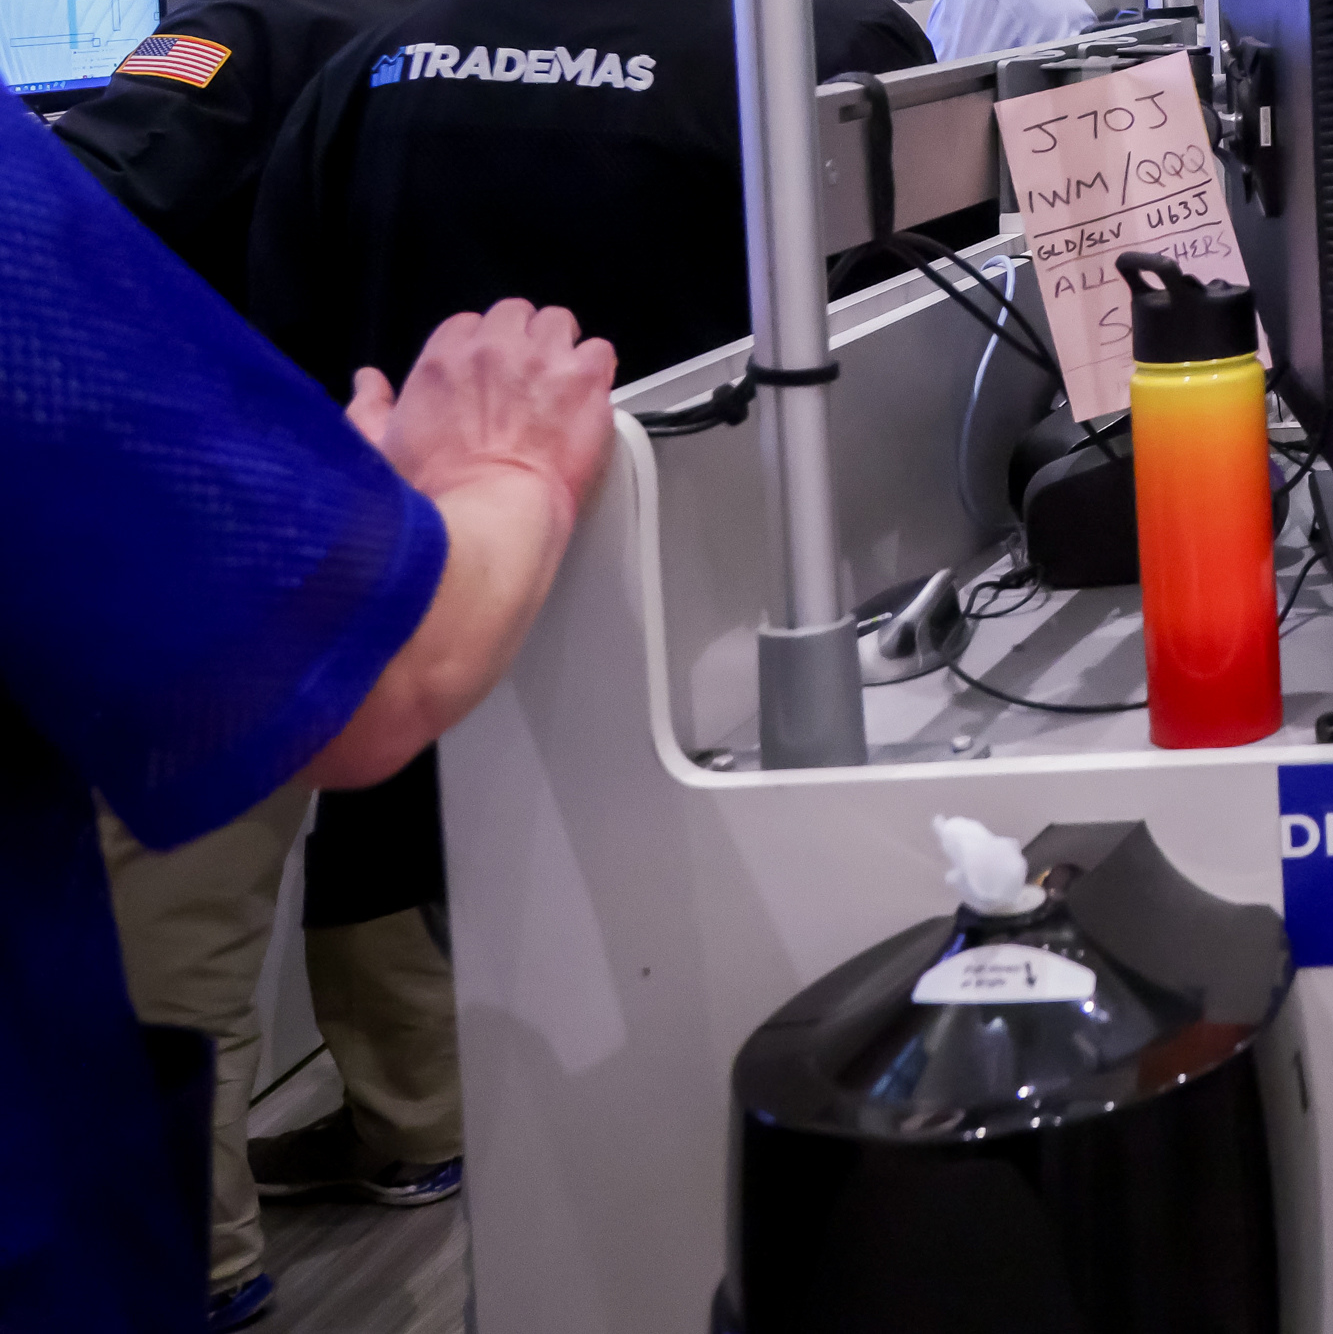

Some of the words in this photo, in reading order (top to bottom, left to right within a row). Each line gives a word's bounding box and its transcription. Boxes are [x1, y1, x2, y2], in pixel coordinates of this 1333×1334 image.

[403, 42, 656, 92] TRADEMAS
[1054, 266, 1120, 299] ALL
[1158, 230, 1233, 264] HERS
